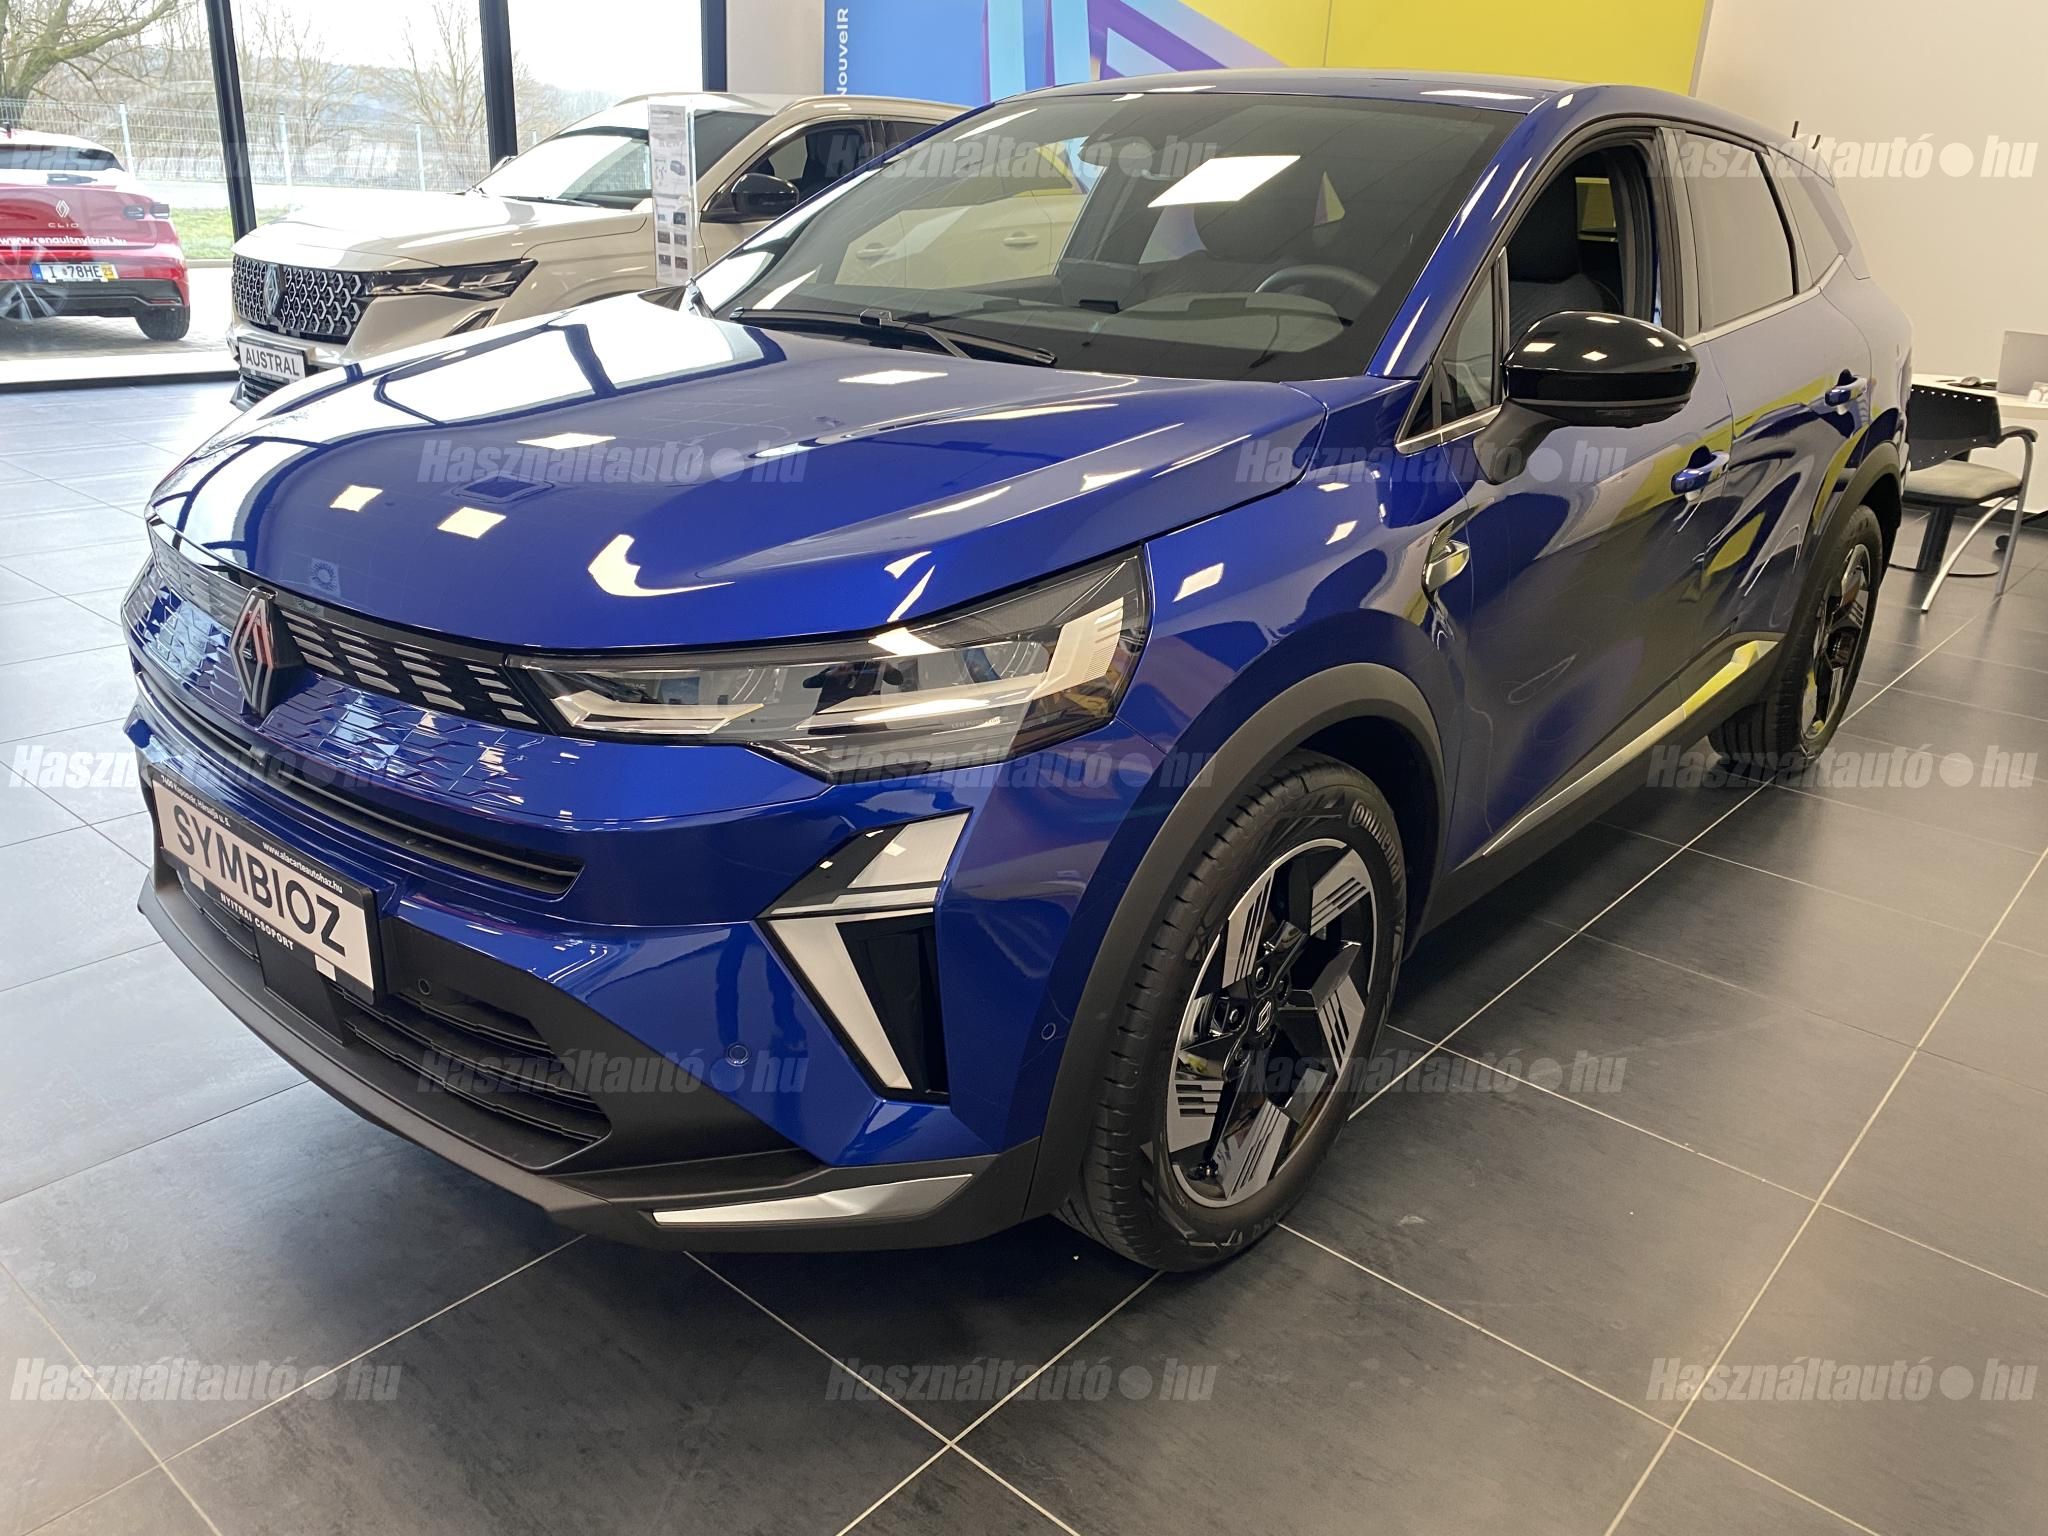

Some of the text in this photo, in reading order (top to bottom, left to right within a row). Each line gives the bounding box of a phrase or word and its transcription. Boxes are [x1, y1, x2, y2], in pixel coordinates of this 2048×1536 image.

[246, 347, 300, 376] AUSTRAL
[173, 805, 346, 958] SYMBIOZ
[220, 892, 294, 951] NYITRAI CSOPORT
